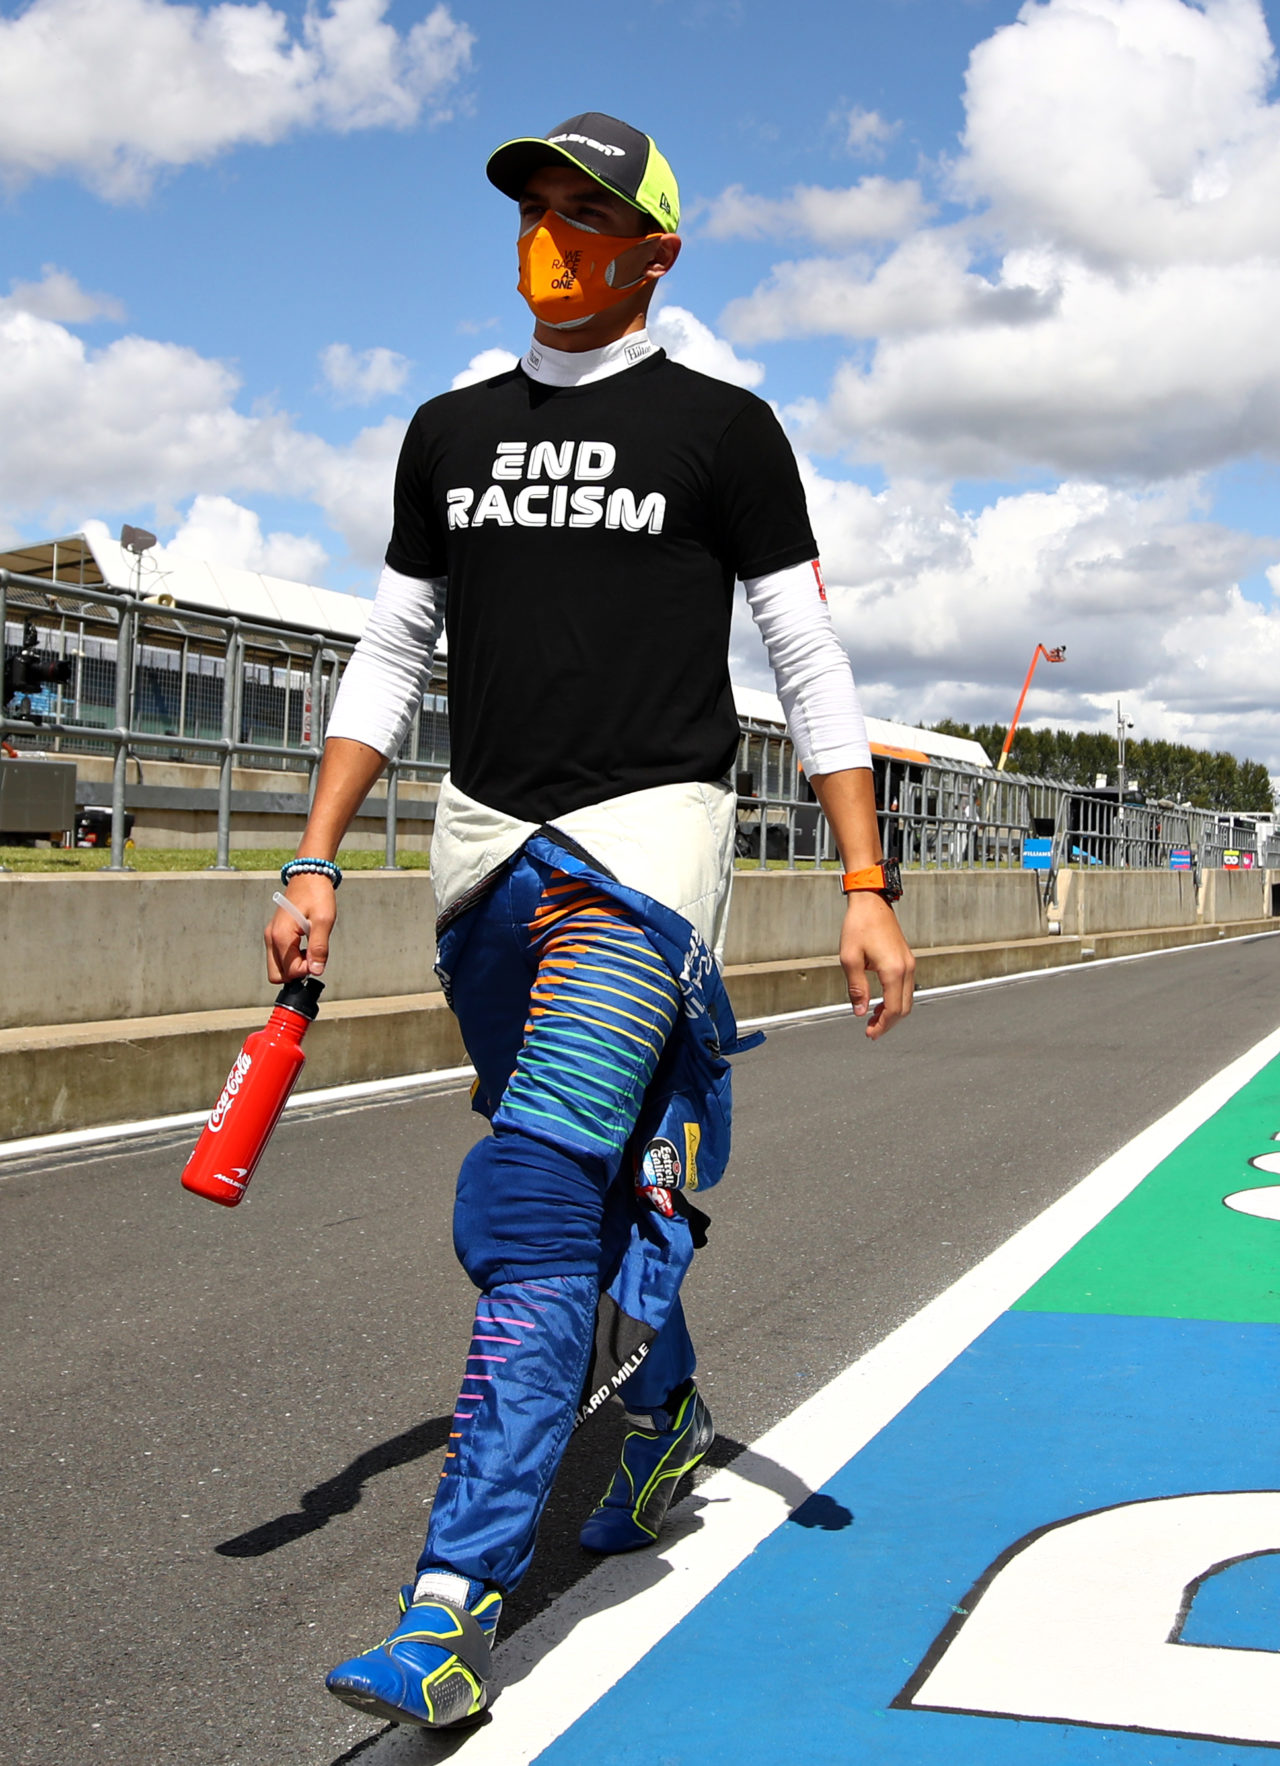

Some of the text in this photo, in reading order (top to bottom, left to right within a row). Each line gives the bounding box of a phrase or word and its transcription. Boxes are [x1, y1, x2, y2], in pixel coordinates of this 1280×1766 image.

[565, 250, 583, 262] WE
[552, 259, 580, 270] RACE
[561, 270, 578, 279] AS
[551, 279, 574, 289] ONE
[627, 345, 651, 361] Hilton
[491, 440, 616, 481] END
[446, 485, 667, 535] RACISM
[610, 1342, 650, 1388] MILLE
